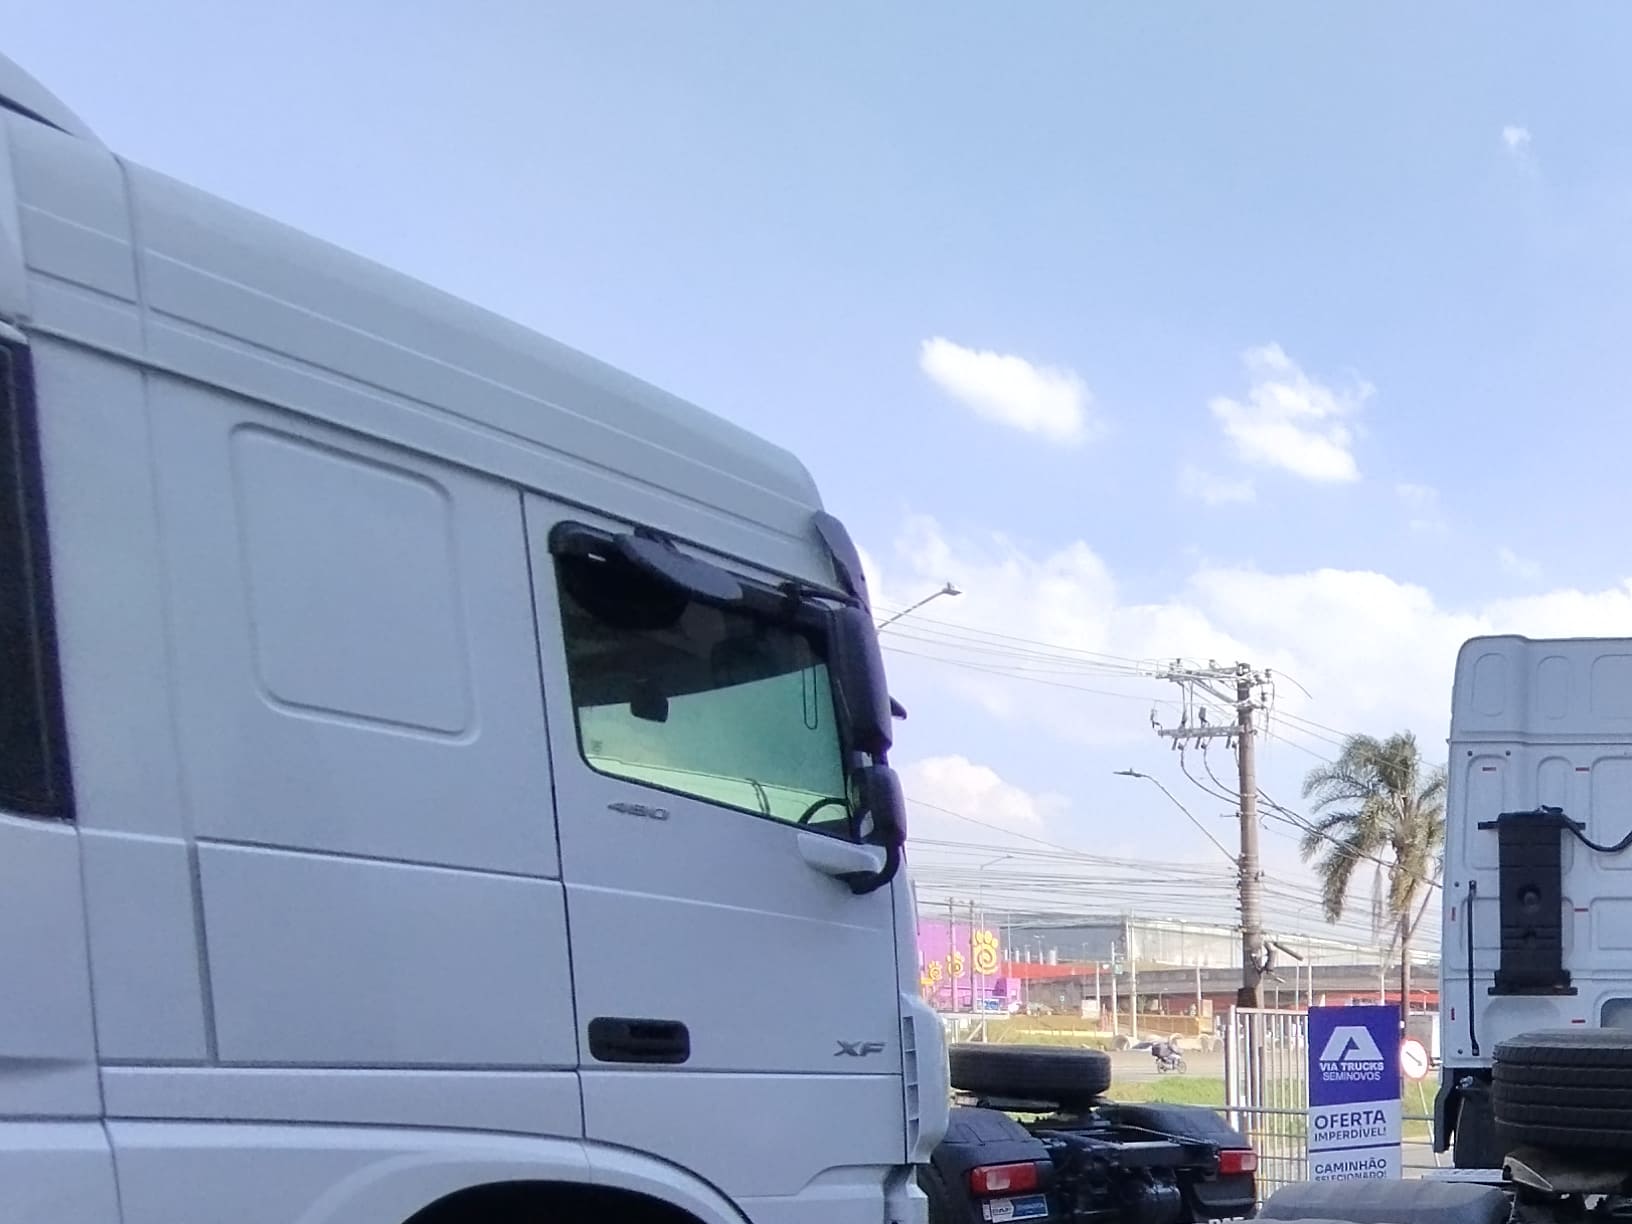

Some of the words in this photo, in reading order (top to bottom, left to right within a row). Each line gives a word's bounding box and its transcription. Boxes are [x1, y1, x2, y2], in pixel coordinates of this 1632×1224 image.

[833, 1039, 886, 1057] XF
[1319, 1062, 1339, 1072] VIA
[1340, 1062, 1385, 1072] TRUCKS
[1322, 1072, 1381, 1081] SEMINOVOS
[1314, 1110, 1387, 1130] OFERTA
[1314, 1127, 1388, 1143] IMPERDÍVEL!
[1314, 1157, 1388, 1175] CAMINHÃO
